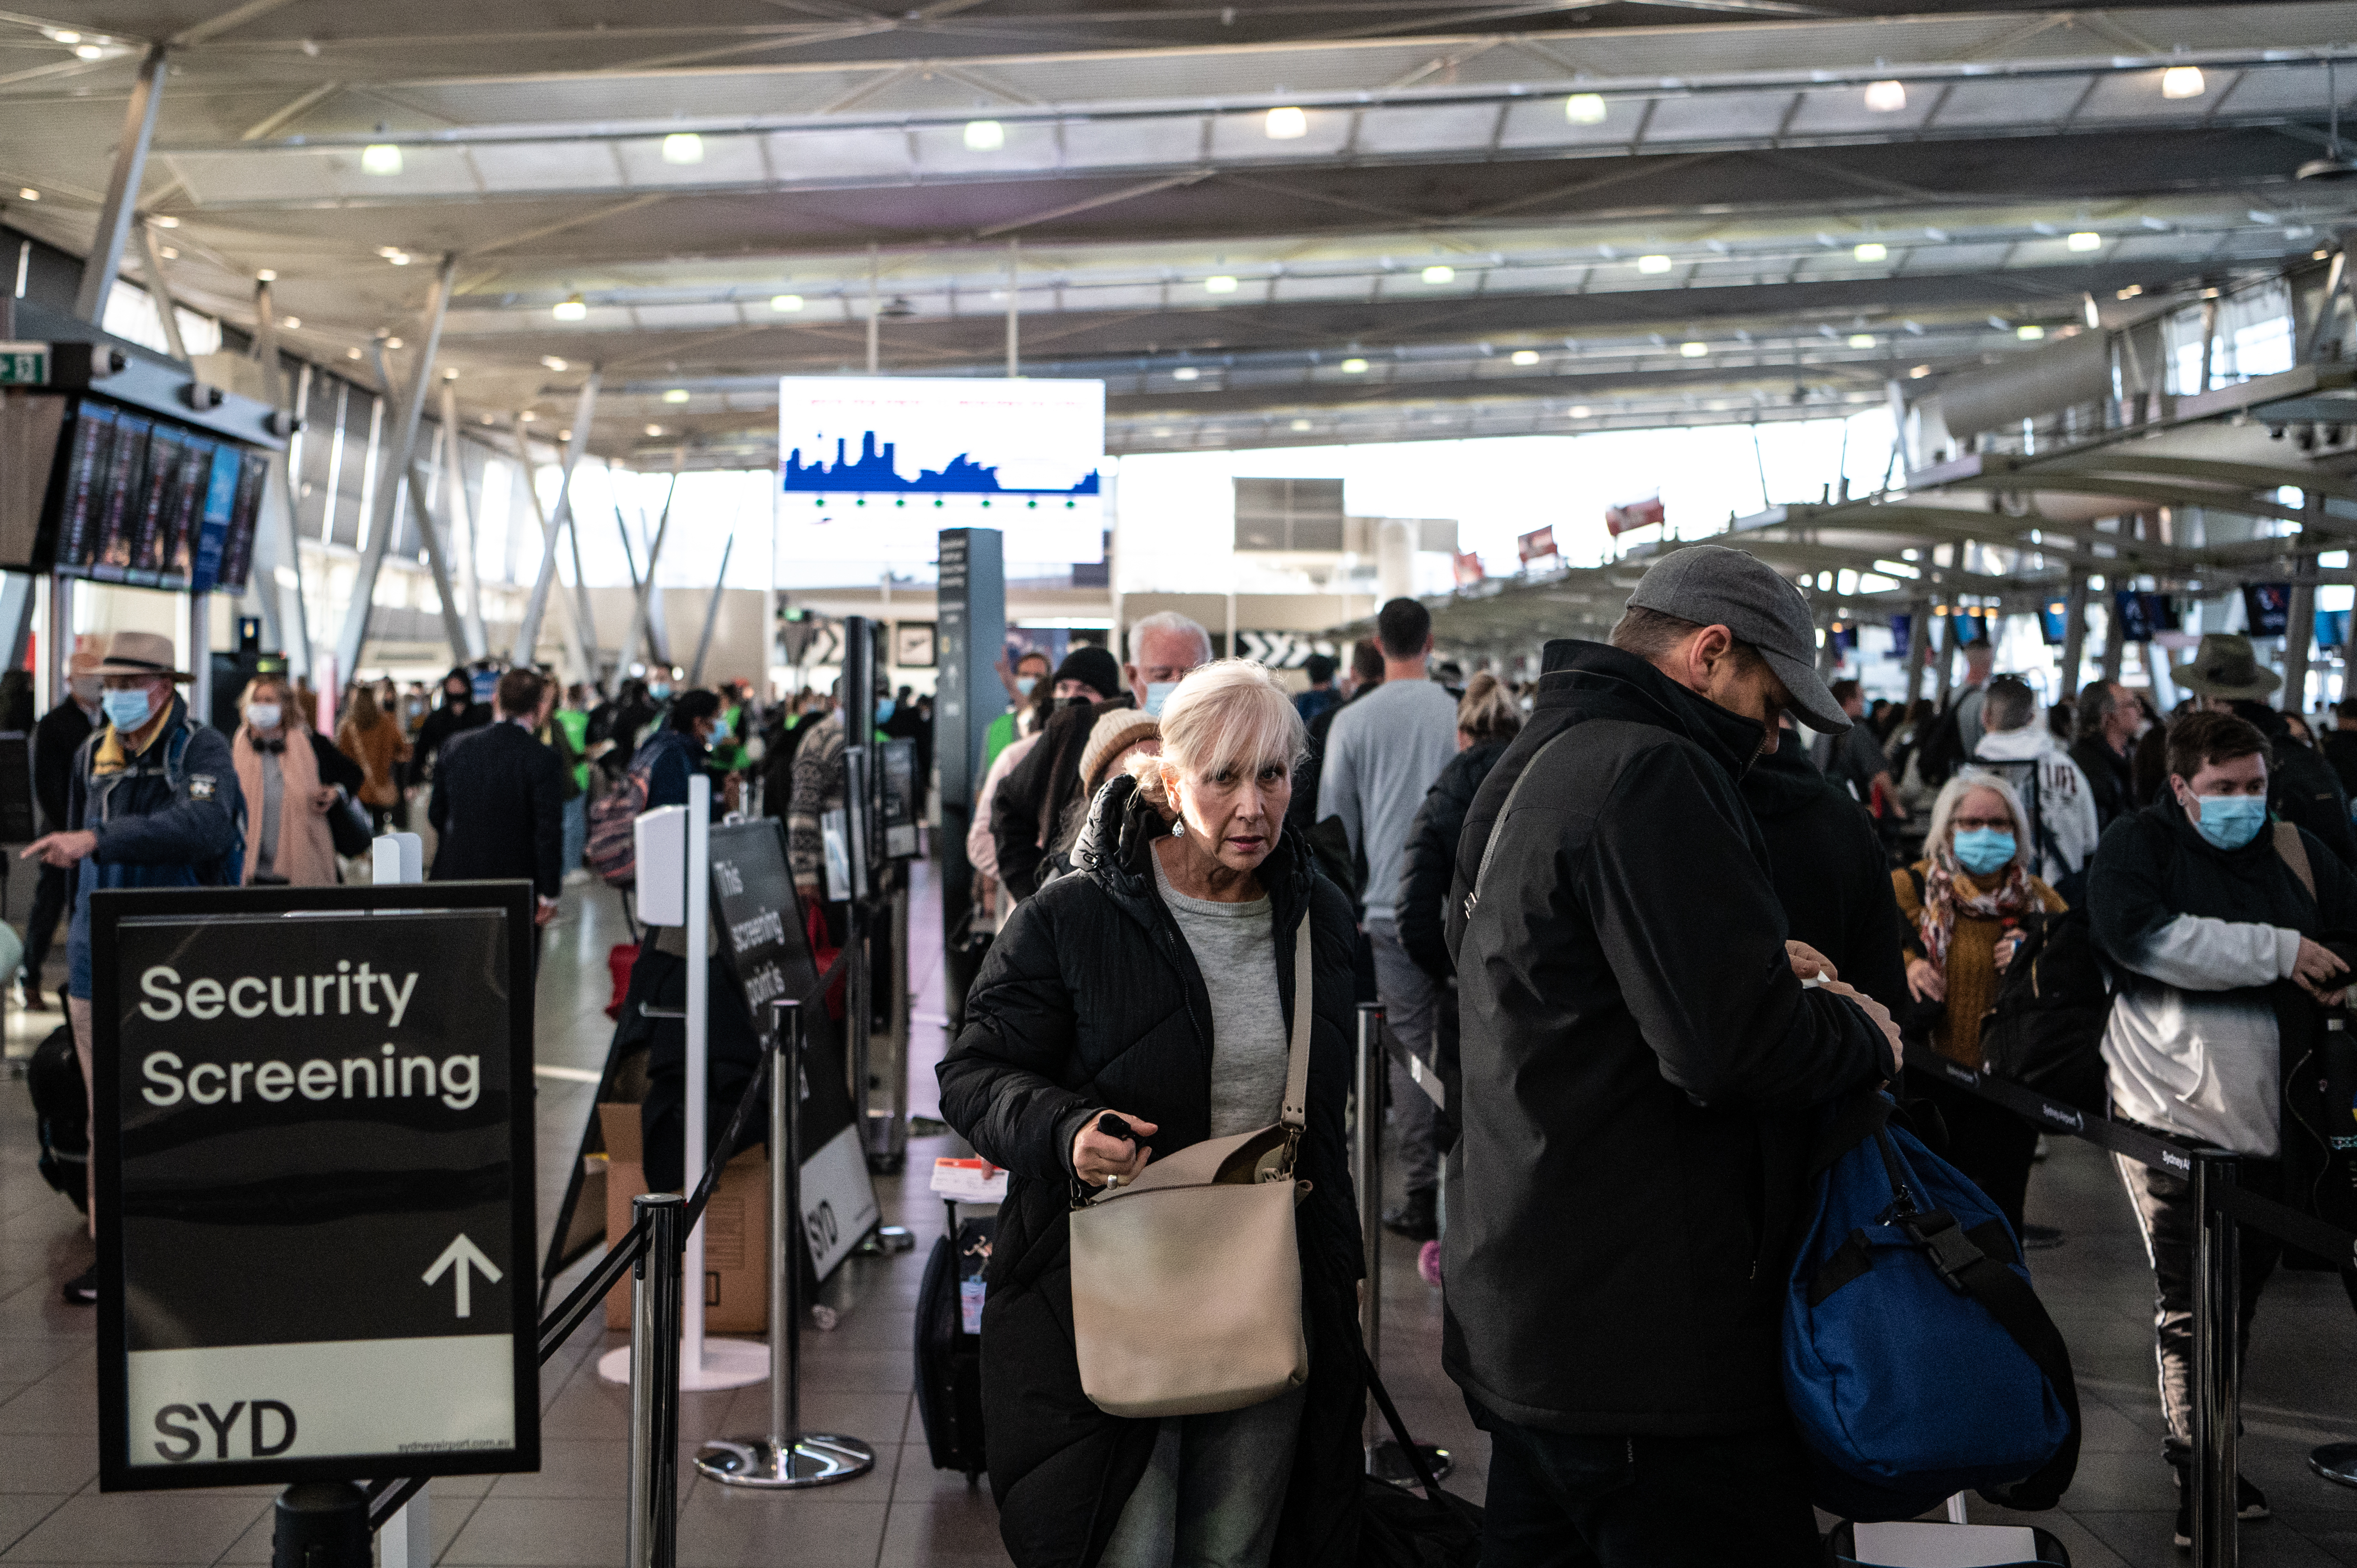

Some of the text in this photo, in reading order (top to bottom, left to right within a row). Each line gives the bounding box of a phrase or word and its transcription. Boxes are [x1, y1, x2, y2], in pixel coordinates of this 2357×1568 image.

[713, 858, 744, 896] This
[731, 905, 785, 952] screening
[139, 960, 419, 1027] Security
[141, 1043, 480, 1110] Screening
[2162, 1150, 2183, 1169] Sydney
[807, 1199, 838, 1260] SYD
[154, 1399, 297, 1461] SYD
[398, 1438, 511, 1454] sydneyairport.com.au
